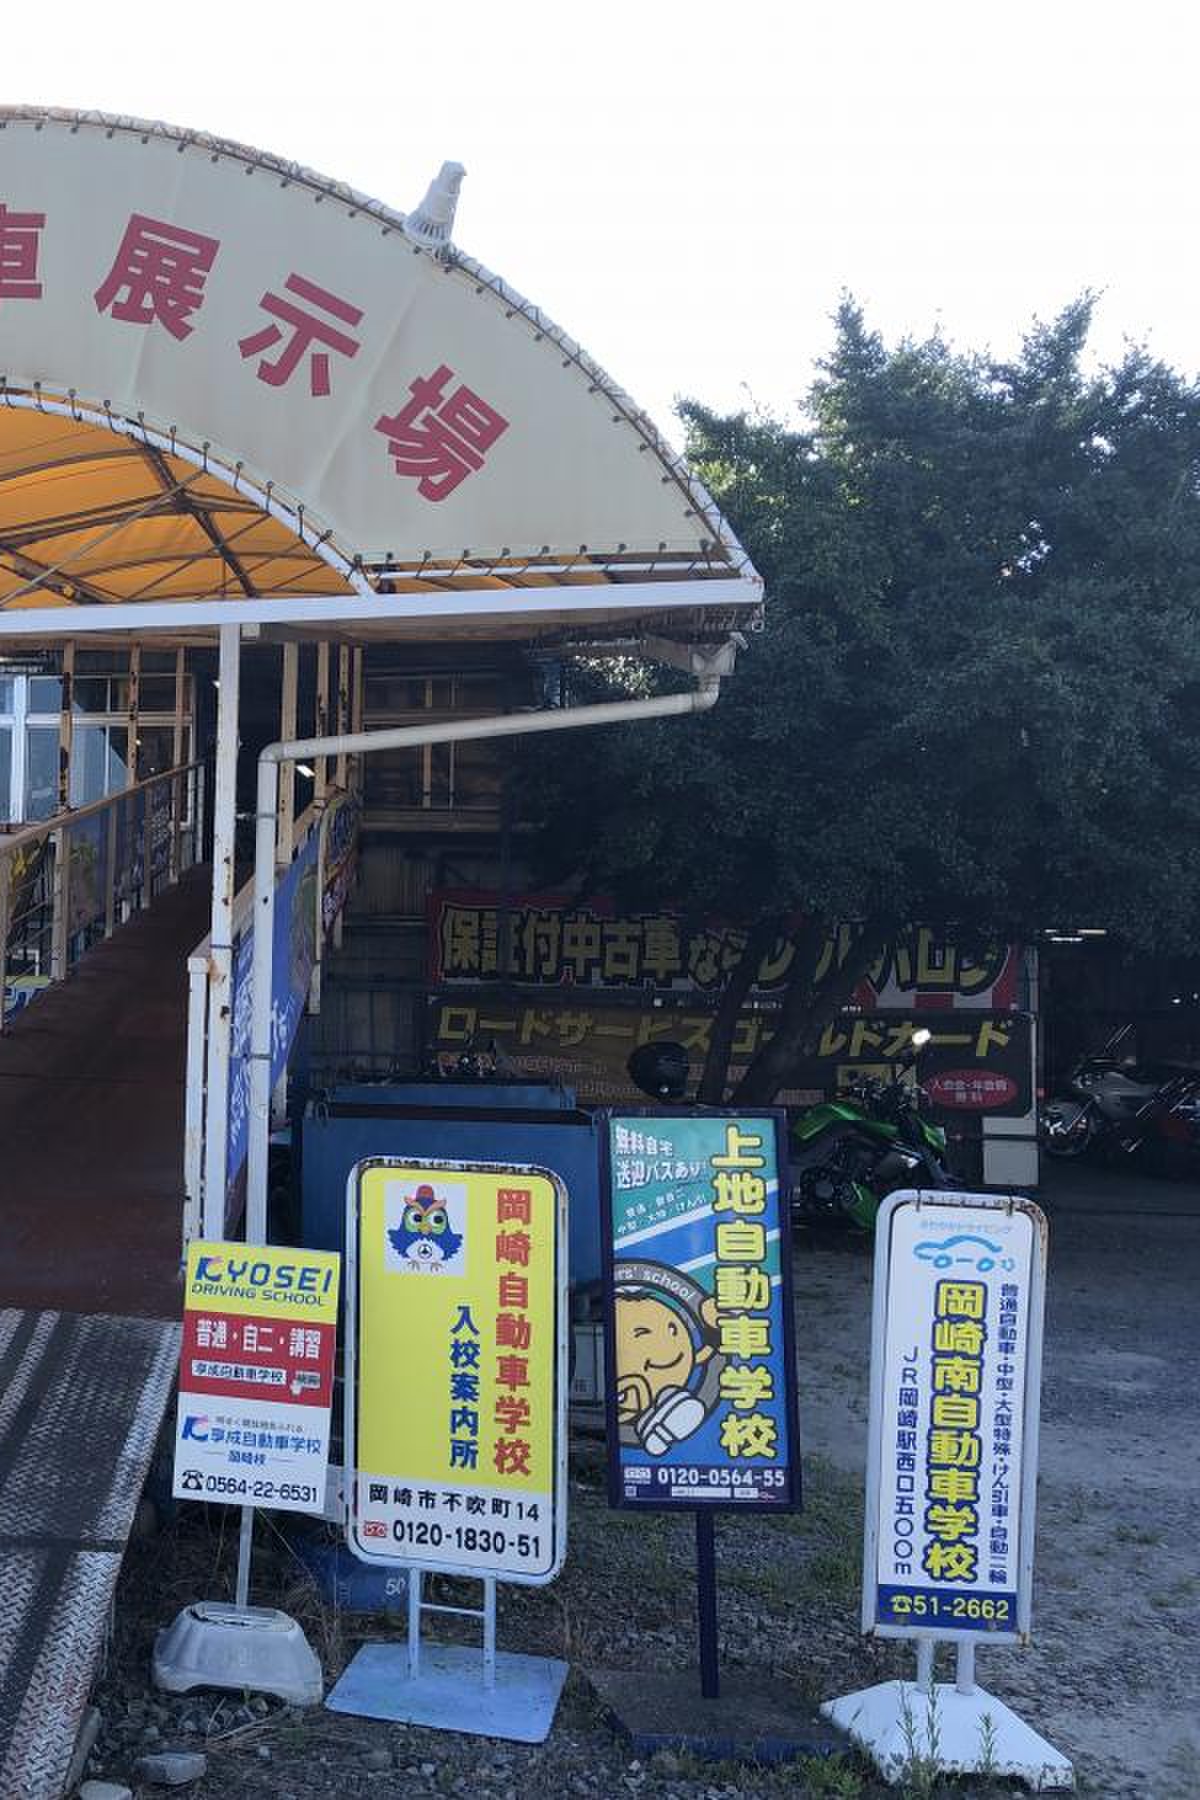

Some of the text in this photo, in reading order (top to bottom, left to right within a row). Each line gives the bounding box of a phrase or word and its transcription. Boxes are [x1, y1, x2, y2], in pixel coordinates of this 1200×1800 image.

[191, 1283, 324, 1306] DRIVING SCHOOL
[711, 1124, 777, 1460] 上地自動車学校
[493, 1188, 531, 1475] 岡崎自動車学校
[449, 1305, 480, 1471] 入校案内所
[925, 1283, 985, 1581] 岡崎南自動車学校
[205, 1475, 318, 1503] 0564-22-6531
[657, 1467, 786, 1488] 0120-0564-55
[369, 1483, 539, 1522] 岡崎市不吹町14
[392, 1519, 541, 1559] 0120-1830-51
